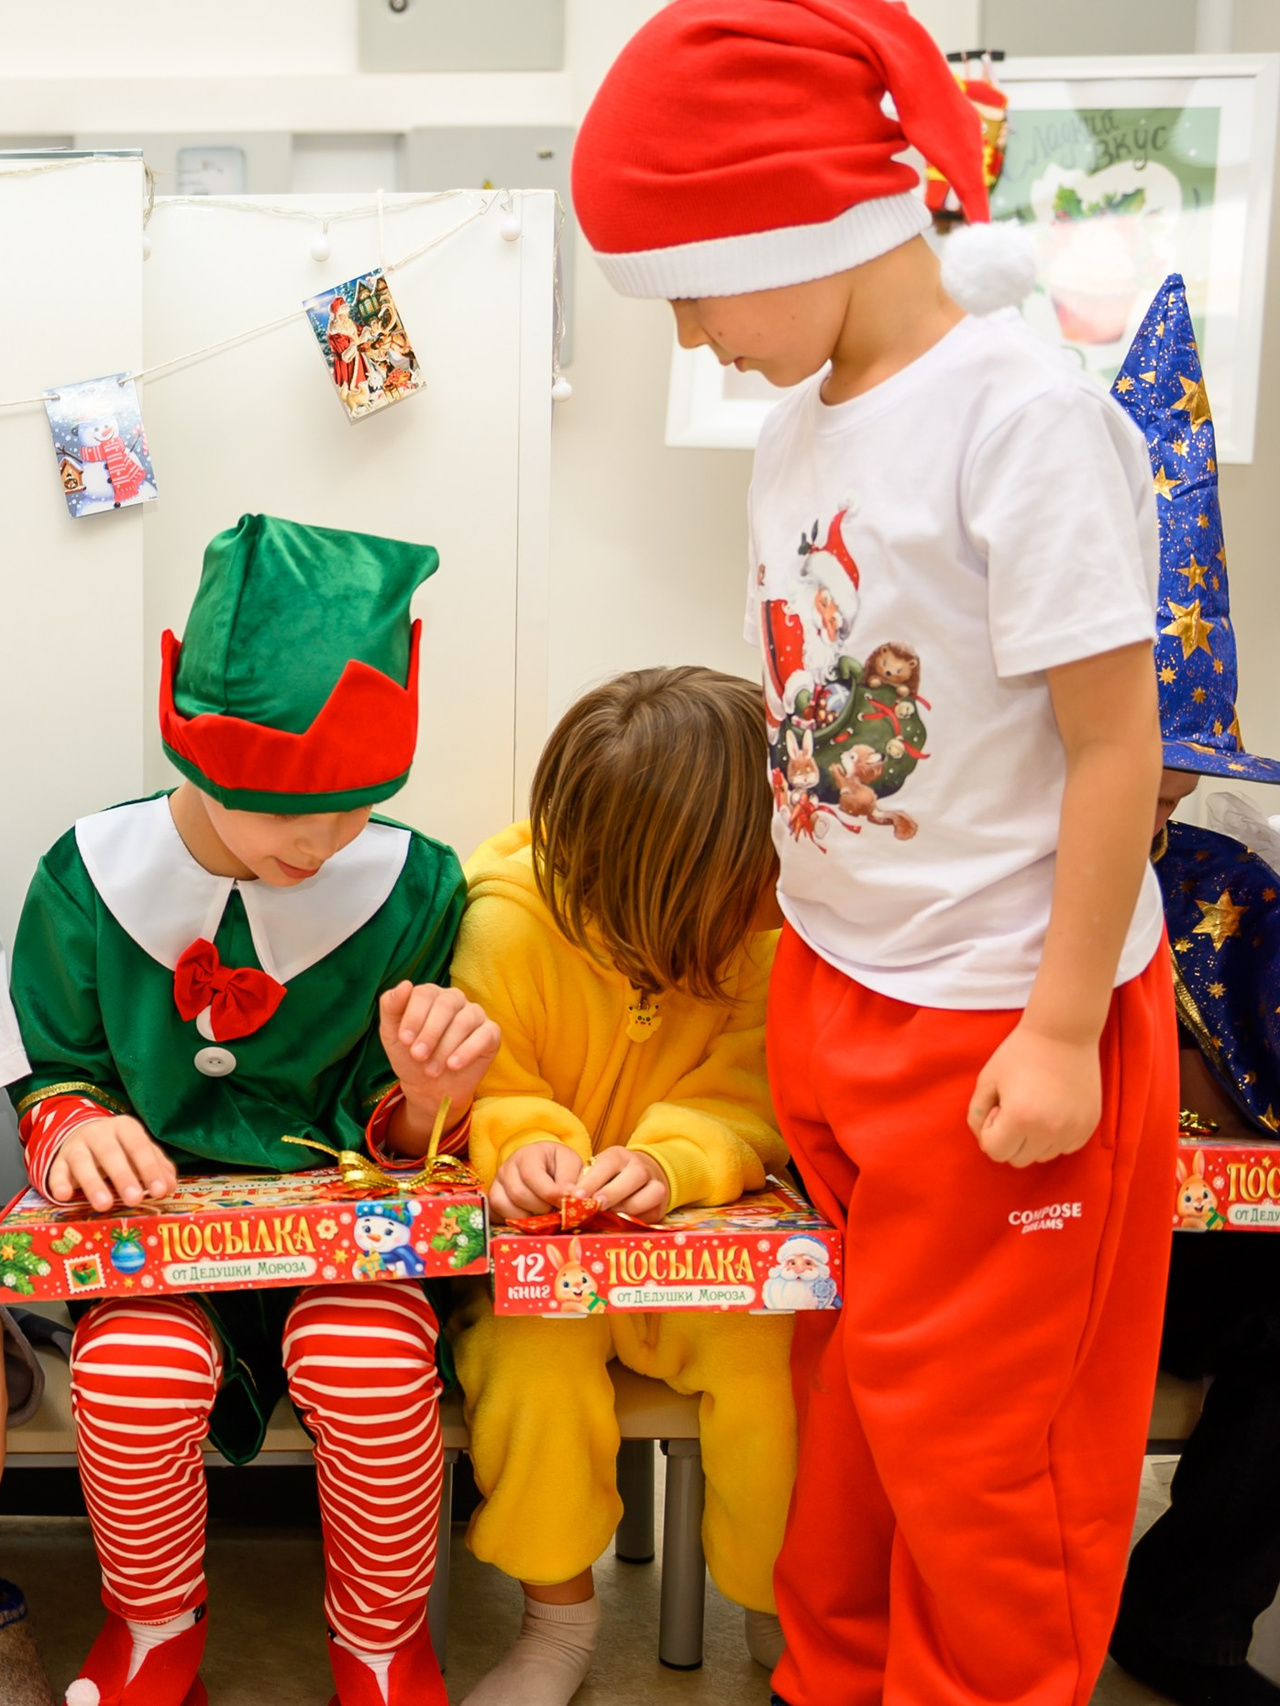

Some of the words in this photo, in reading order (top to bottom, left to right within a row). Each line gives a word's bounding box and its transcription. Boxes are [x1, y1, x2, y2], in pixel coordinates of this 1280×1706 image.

[1008, 1202, 1083, 1226] COMPOSE
[1021, 1218, 1065, 1235] DREAMS
[157, 1214, 317, 1262] ПОСЫЛКА
[510, 1252, 546, 1283] 12
[605, 1245, 757, 1285] ПОСЫЛКА
[507, 1284, 551, 1301] книг
